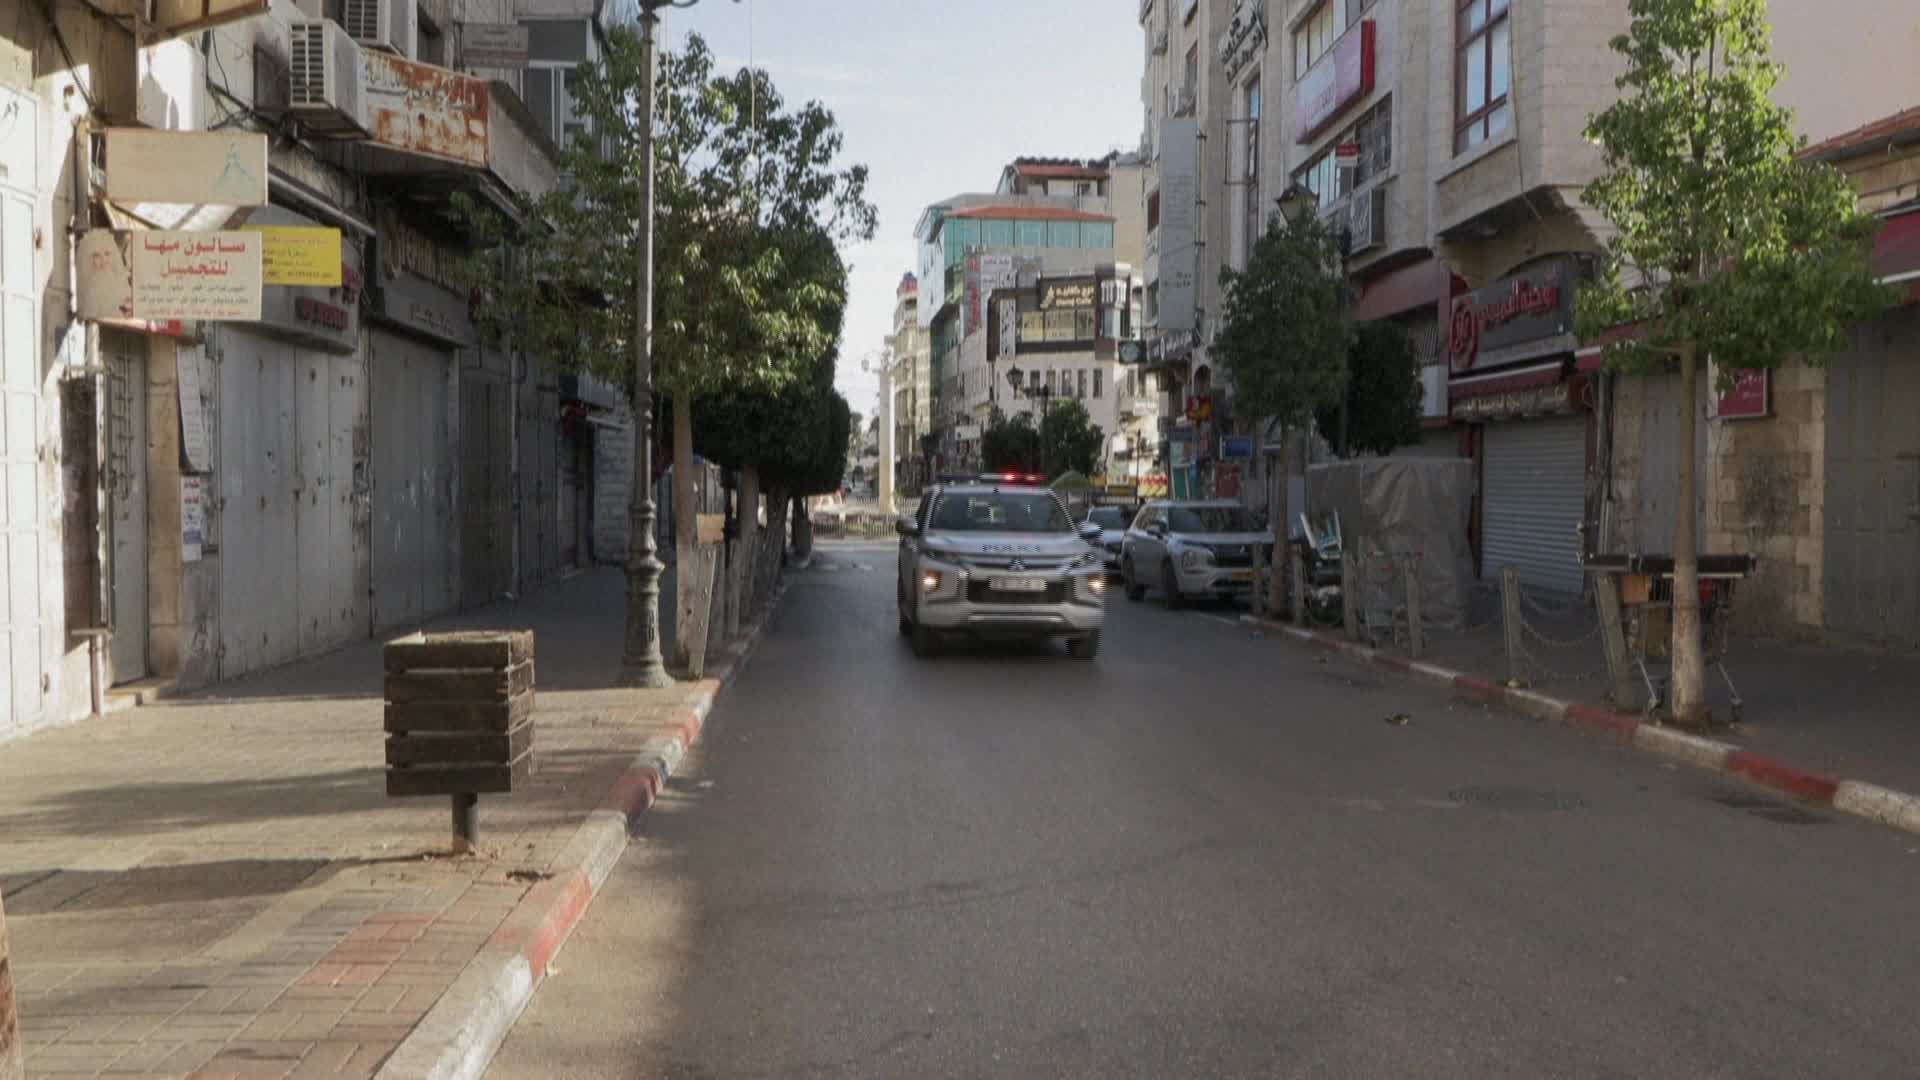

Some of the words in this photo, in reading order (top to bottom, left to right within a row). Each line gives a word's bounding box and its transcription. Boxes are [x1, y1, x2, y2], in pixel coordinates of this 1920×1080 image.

[144, 238, 180, 254] مها
[184, 237, 245, 255] سالون
[161, 260, 228, 278] للتجميل
